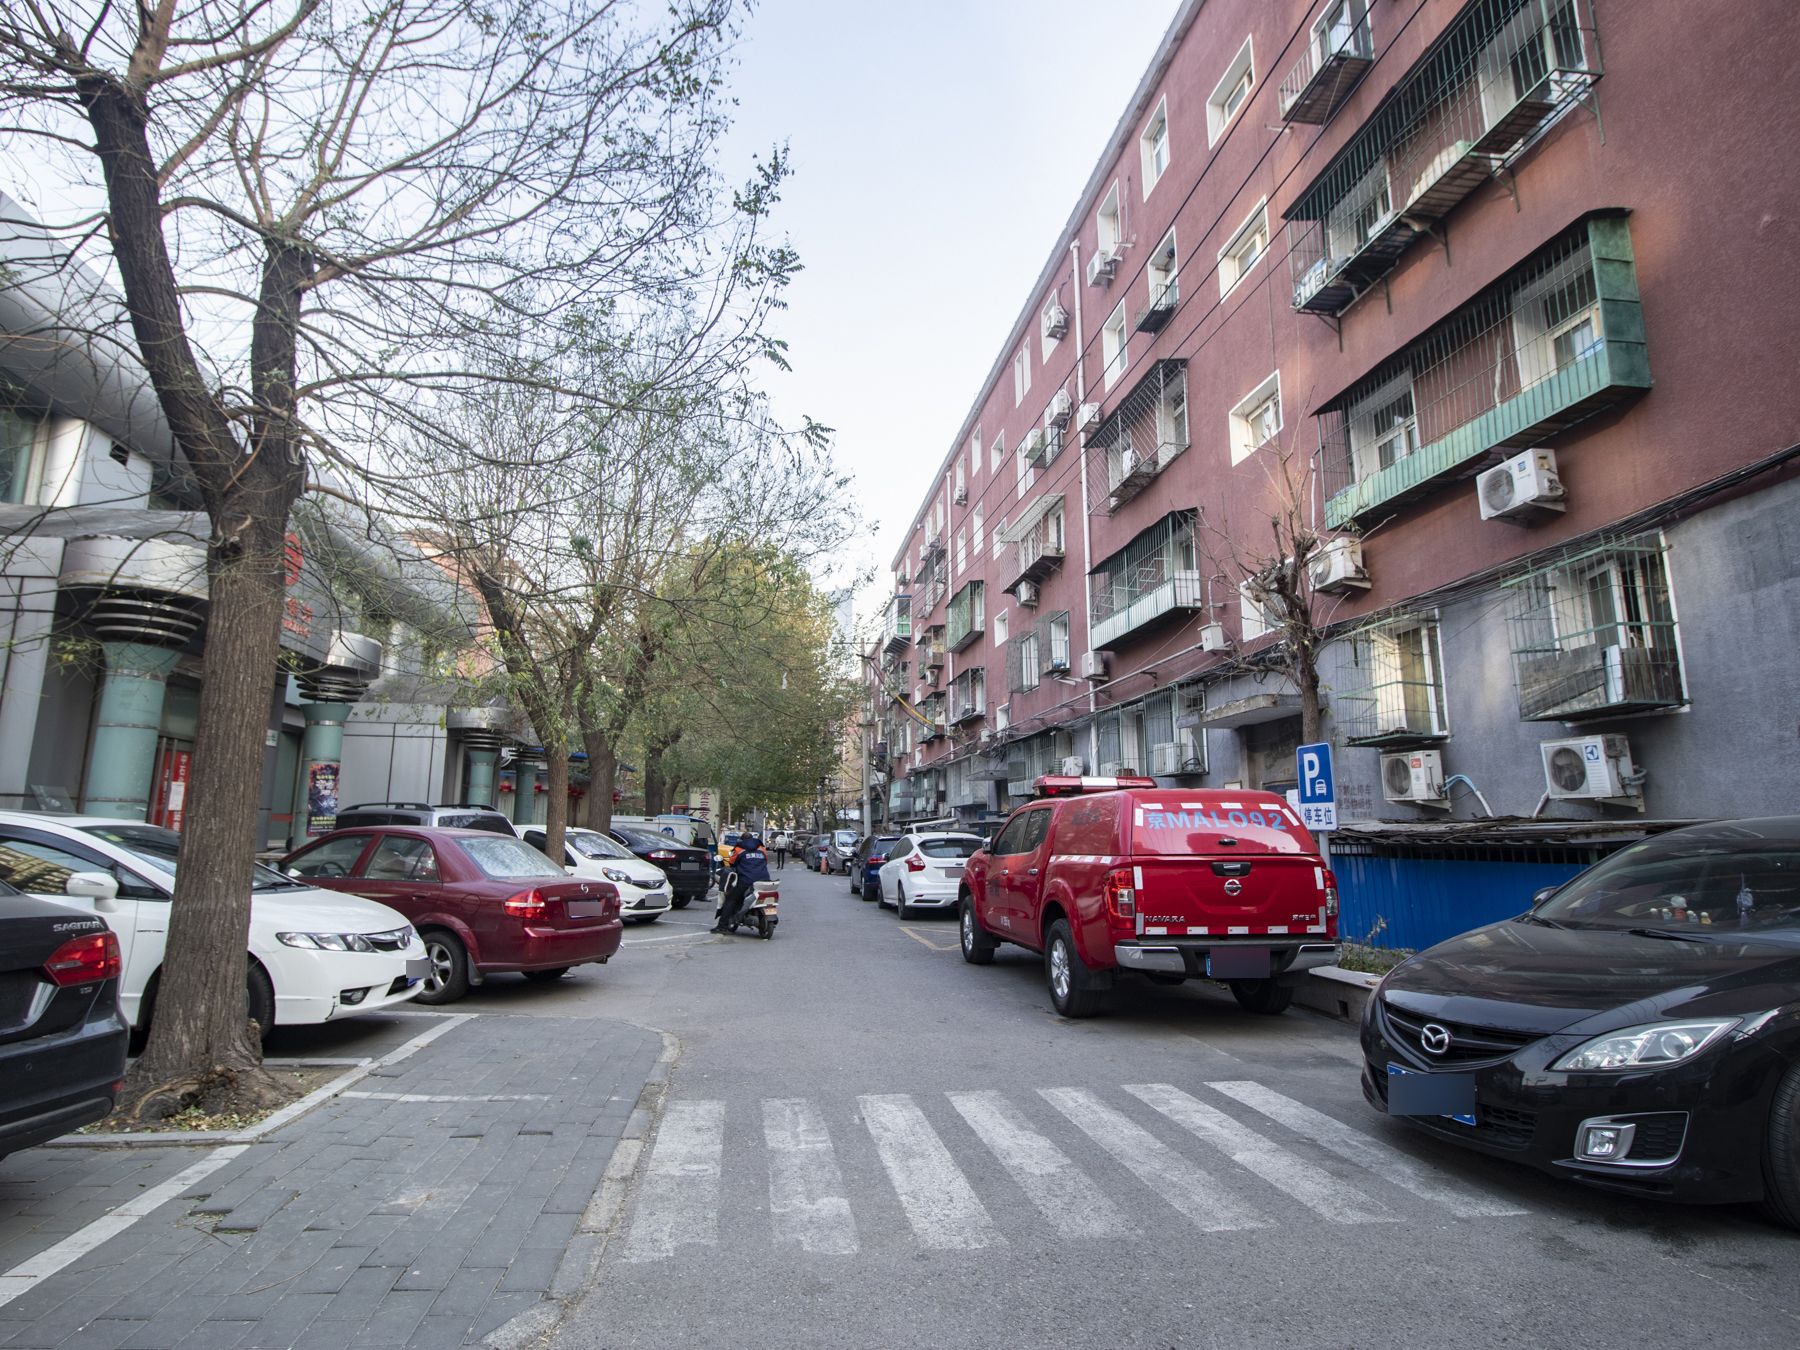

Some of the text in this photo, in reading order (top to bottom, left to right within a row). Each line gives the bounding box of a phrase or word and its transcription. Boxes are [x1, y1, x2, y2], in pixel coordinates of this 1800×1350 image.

[1303, 752, 1320, 797] P
[1304, 807, 1333, 825] 停车位
[1145, 914, 1186, 923] NAVARA
[53, 921, 103, 932] SAGITAR
